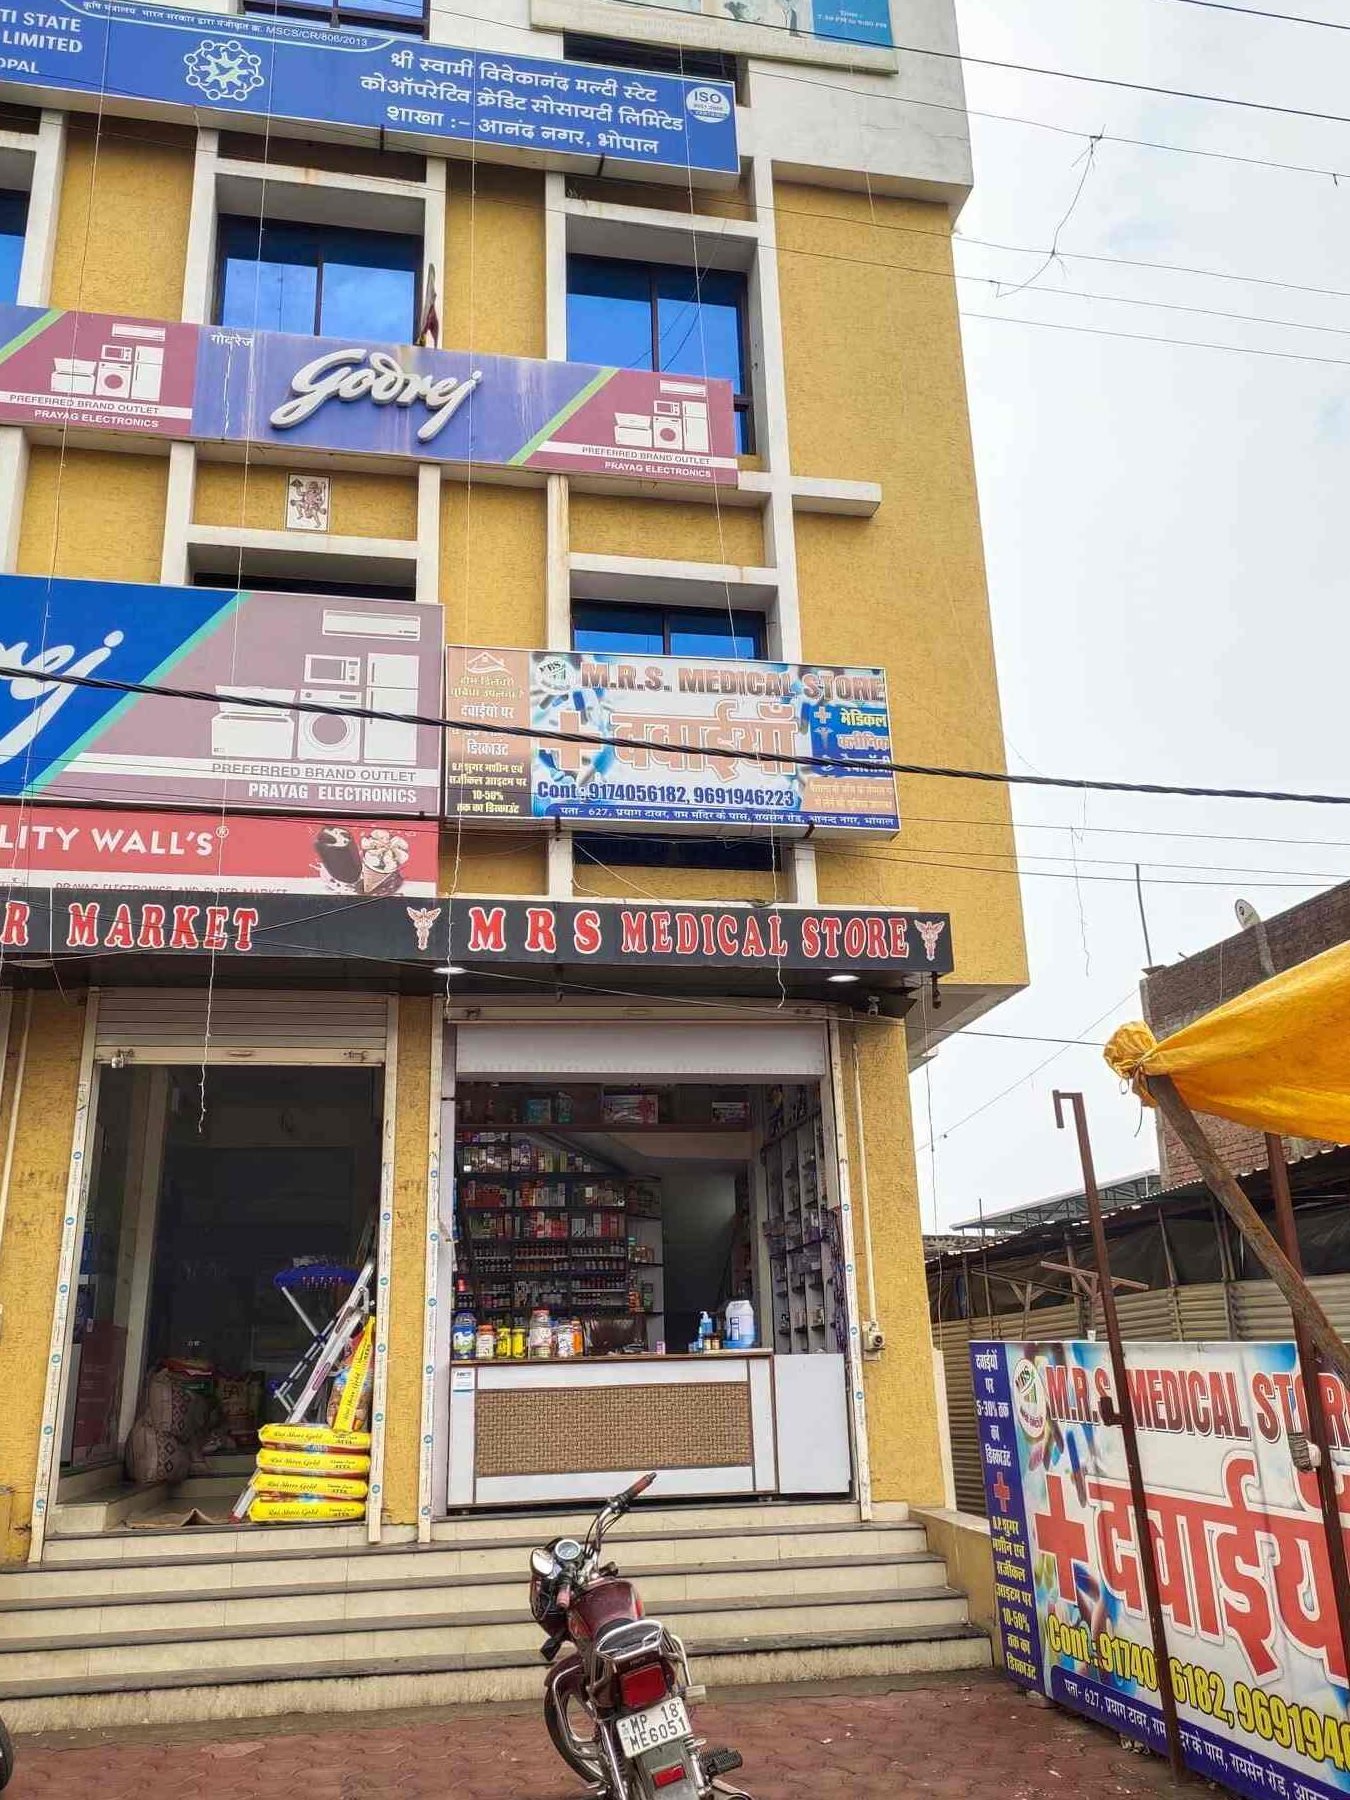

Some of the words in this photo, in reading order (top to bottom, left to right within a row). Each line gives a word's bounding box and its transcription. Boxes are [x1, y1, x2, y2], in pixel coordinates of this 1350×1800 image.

[23, 12, 82, 33] STATE
[3, 30, 83, 53] LIMITED
[389, 50, 413, 71] श्री
[420, 53, 474, 79] स्वामी
[479, 58, 569, 91] विवेकानंद
[575, 74, 618, 99] मल्टी
[623, 80, 658, 103] स्टेट
[360, 72, 471, 104] कोऑपरेटिव
[476, 86, 527, 111] क्रेडिट
[531, 91, 613, 123] सोसायटी
[619, 103, 684, 133] लिमिटेड
[694, 91, 722, 104] ISO
[386, 105, 444, 128] शाखा
[478, 118, 535, 139] आनंद
[540, 125, 592, 149] नगर,
[598, 131, 660, 156] भोपाल
[9, 394, 74, 408] PREFERRED
[76, 399, 116, 412] BRAND
[117, 402, 160, 415] OUTLET
[269, 347, 483, 443] Godrej
[34, 409, 79, 422] PRAYAG
[81, 413, 160, 428] ELECTRONICS
[582, 446, 638, 460] PREFERRED
[640, 451, 673, 463] BRAND
[674, 454, 711, 465] OUTLET
[604, 461, 644, 474] PRAYAG
[646, 464, 712, 478] ELECTRONICS
[580, 661, 673, 693] M.R.S.
[677, 667, 797, 698] MEDICAL
[802, 673, 887, 702] STORE
[211, 762, 300, 778] PREFERRED
[304, 767, 356, 780] BRAND
[360, 770, 417, 782] OUTLET
[249, 782, 309, 800] PRAYAG
[318, 785, 417, 804] ELECTRONICS
[693, 786, 795, 807] 9691946223
[66, 903, 259, 951] MARKET
[620, 910, 789, 958] MEDICAL
[801, 915, 910, 960] STORE
[1125, 1367, 1251, 1441] MEDICAL
[629, 1714, 648, 1735] MP
[660, 1702, 679, 1722] 18
[629, 1716, 687, 1752] ME6051
